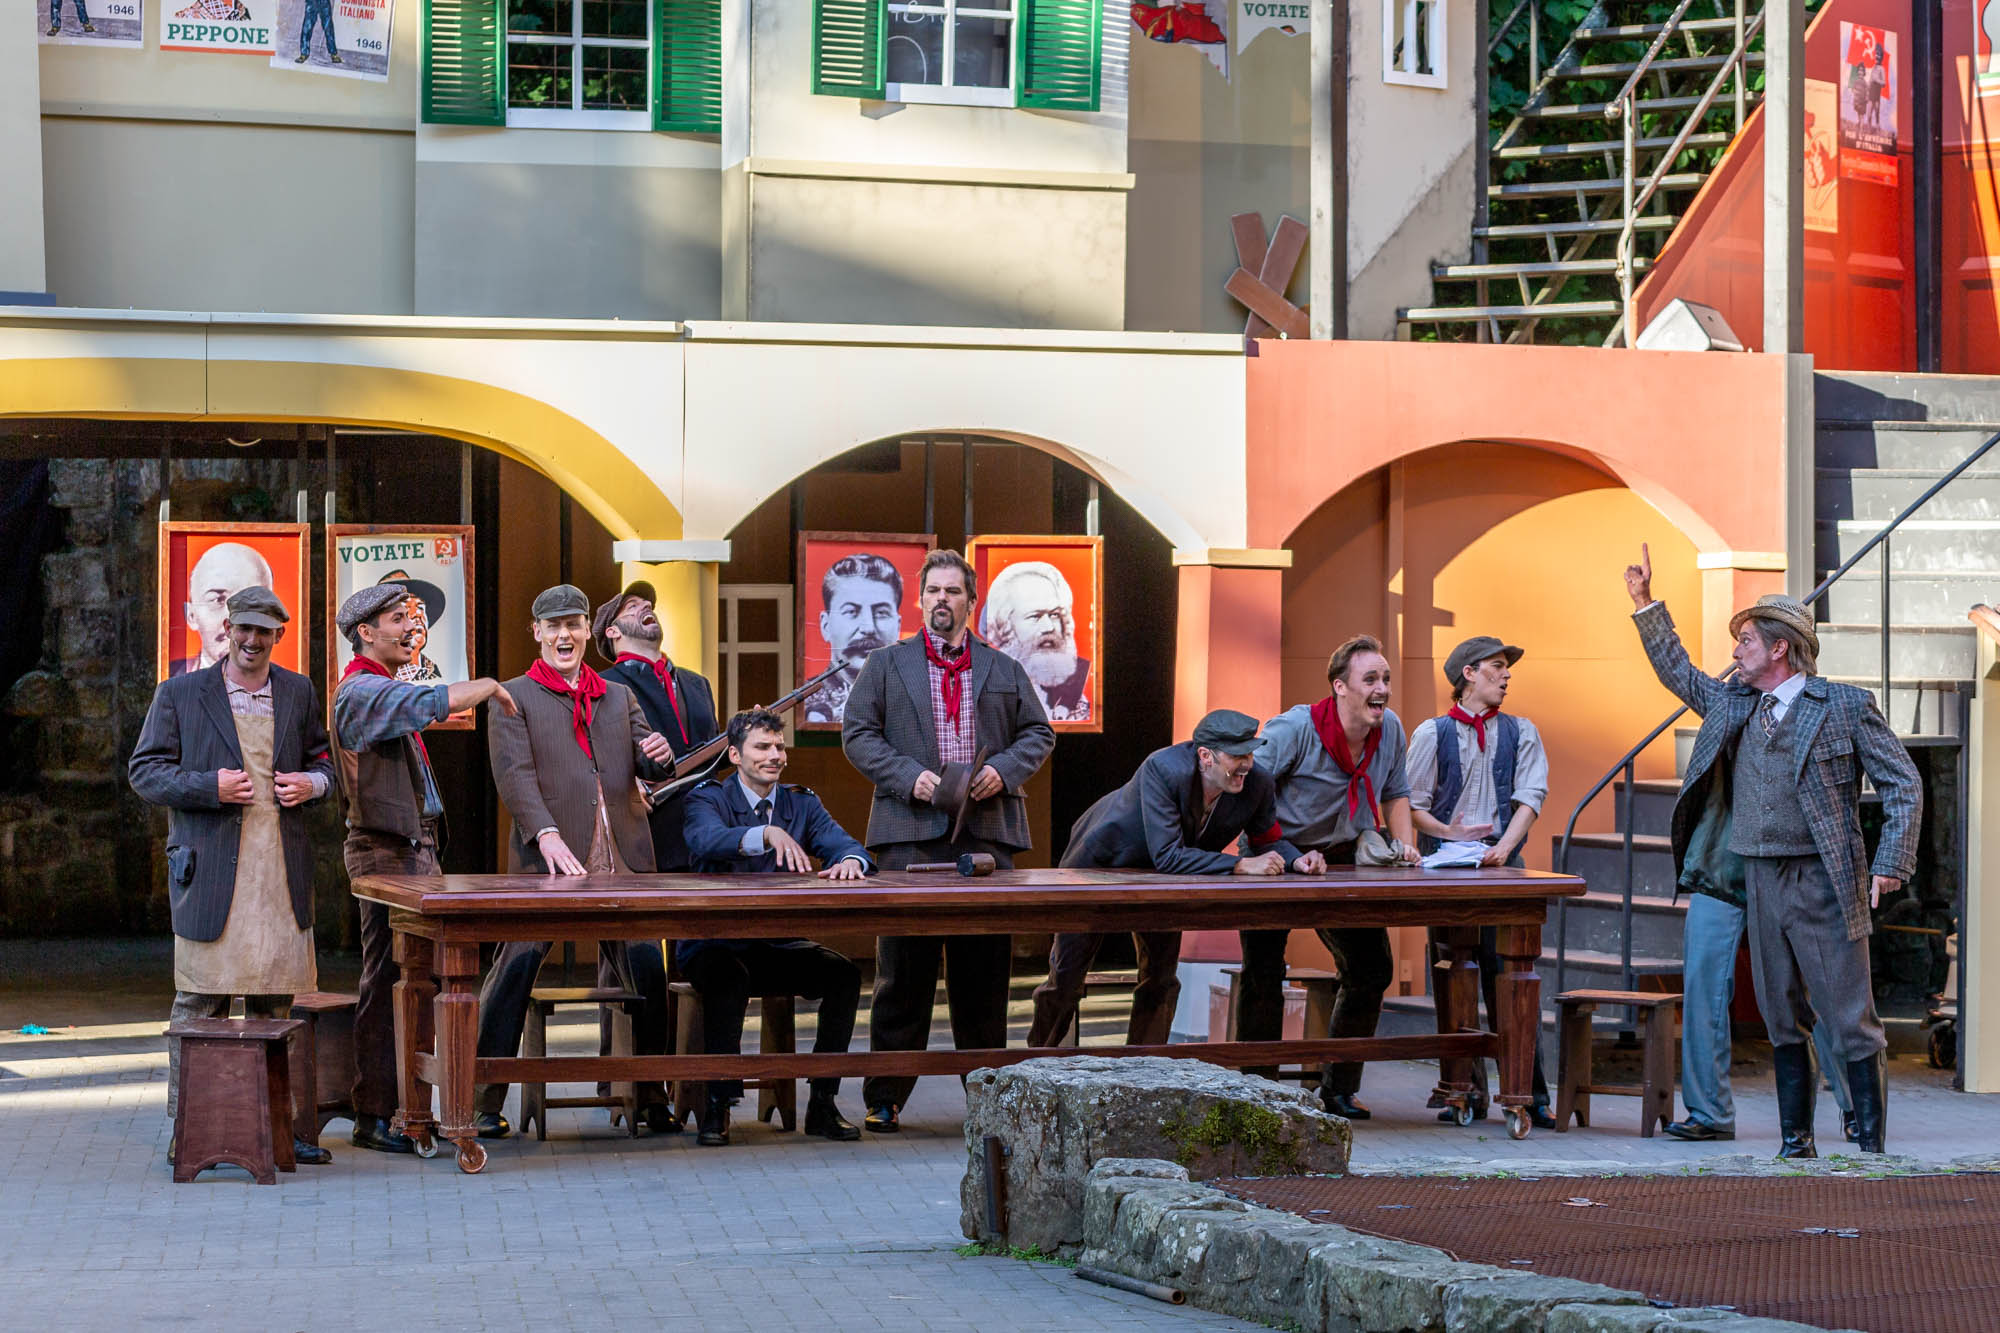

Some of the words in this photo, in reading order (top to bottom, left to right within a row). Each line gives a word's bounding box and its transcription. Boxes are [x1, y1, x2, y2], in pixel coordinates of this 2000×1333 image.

[107, 4, 135, 16] 1946
[340, 6, 375, 20] ITALIANO
[1243, 2, 1309, 18] VOTATE
[167, 23, 269, 45] PEPPONE
[356, 38, 382, 50] 1946
[339, 542, 425, 563] VOTATE
